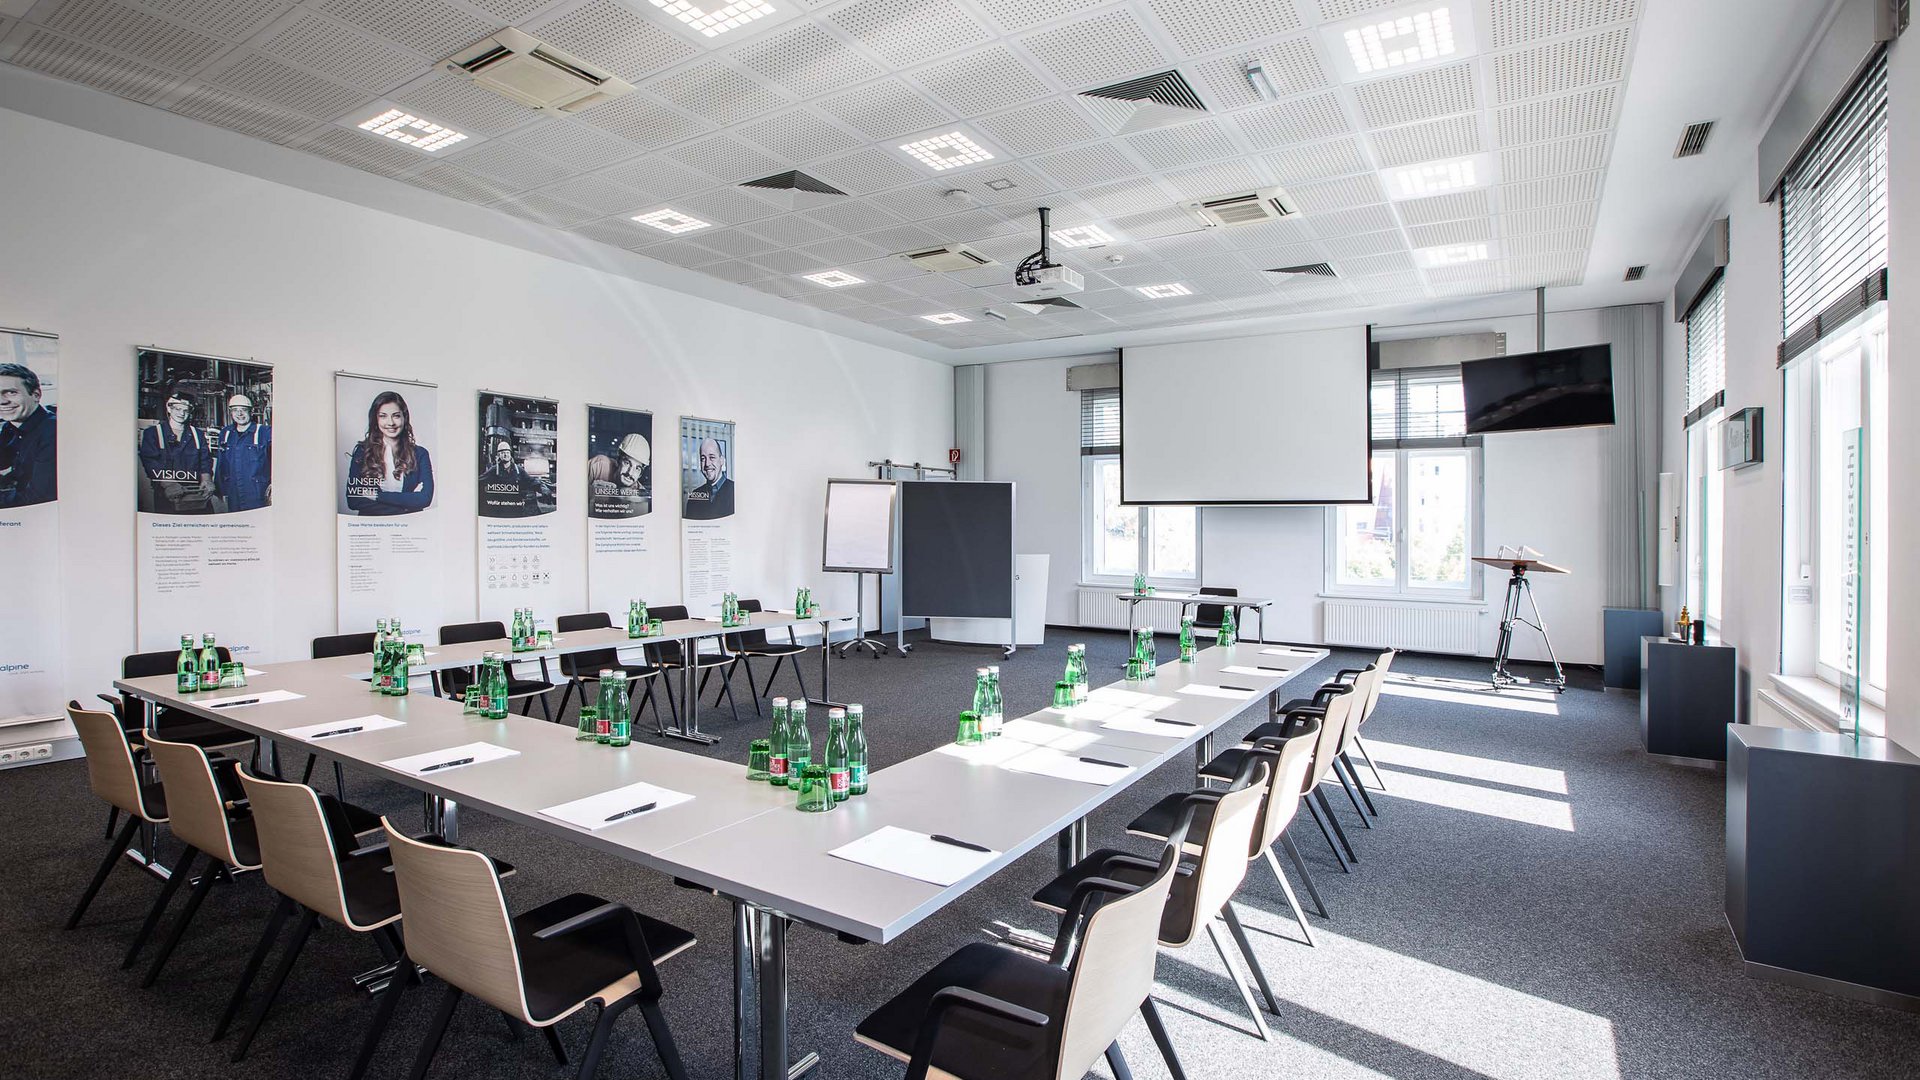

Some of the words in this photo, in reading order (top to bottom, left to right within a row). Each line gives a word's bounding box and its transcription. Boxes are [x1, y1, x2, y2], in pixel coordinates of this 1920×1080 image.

[152, 469, 198, 480] VISION
[348, 477, 384, 486] UNSERE
[347, 486, 378, 496] WERTE
[487, 483, 519, 492] MISSION
[595, 488, 619, 496] UNSERE
